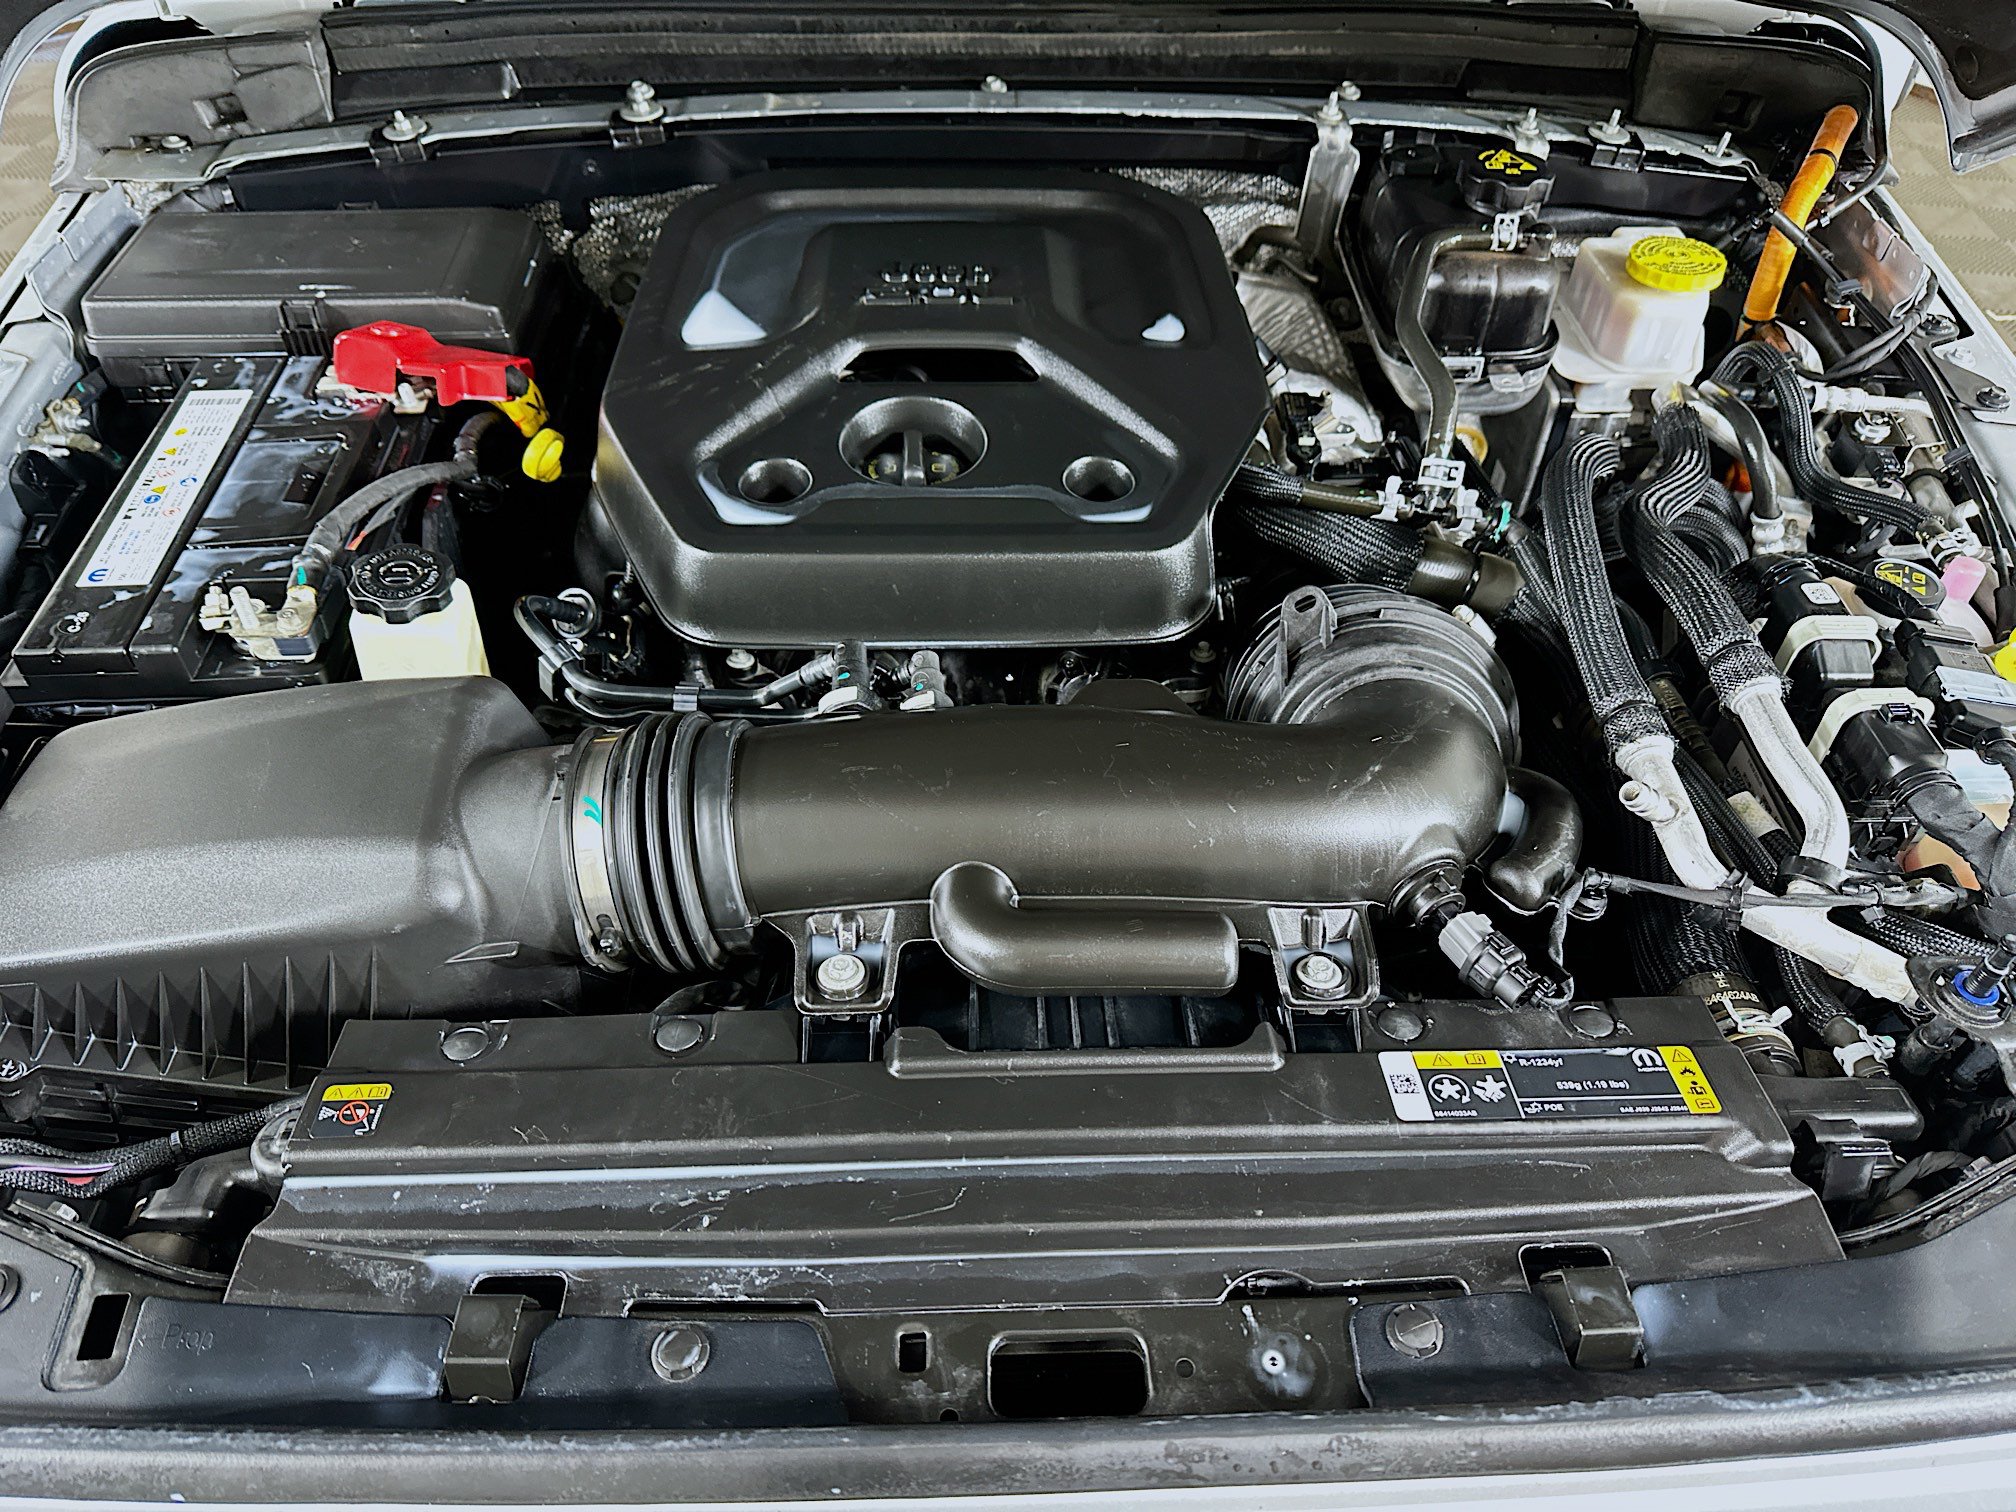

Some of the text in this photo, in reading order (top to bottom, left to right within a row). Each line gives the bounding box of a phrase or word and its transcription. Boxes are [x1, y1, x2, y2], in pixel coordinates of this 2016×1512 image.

[880, 263, 990, 287] Jeep
[1518, 1057, 1564, 1068] R-1234yf
[1608, 1079, 1630, 1090] lbs)
[1543, 1103, 1565, 1112] POE
